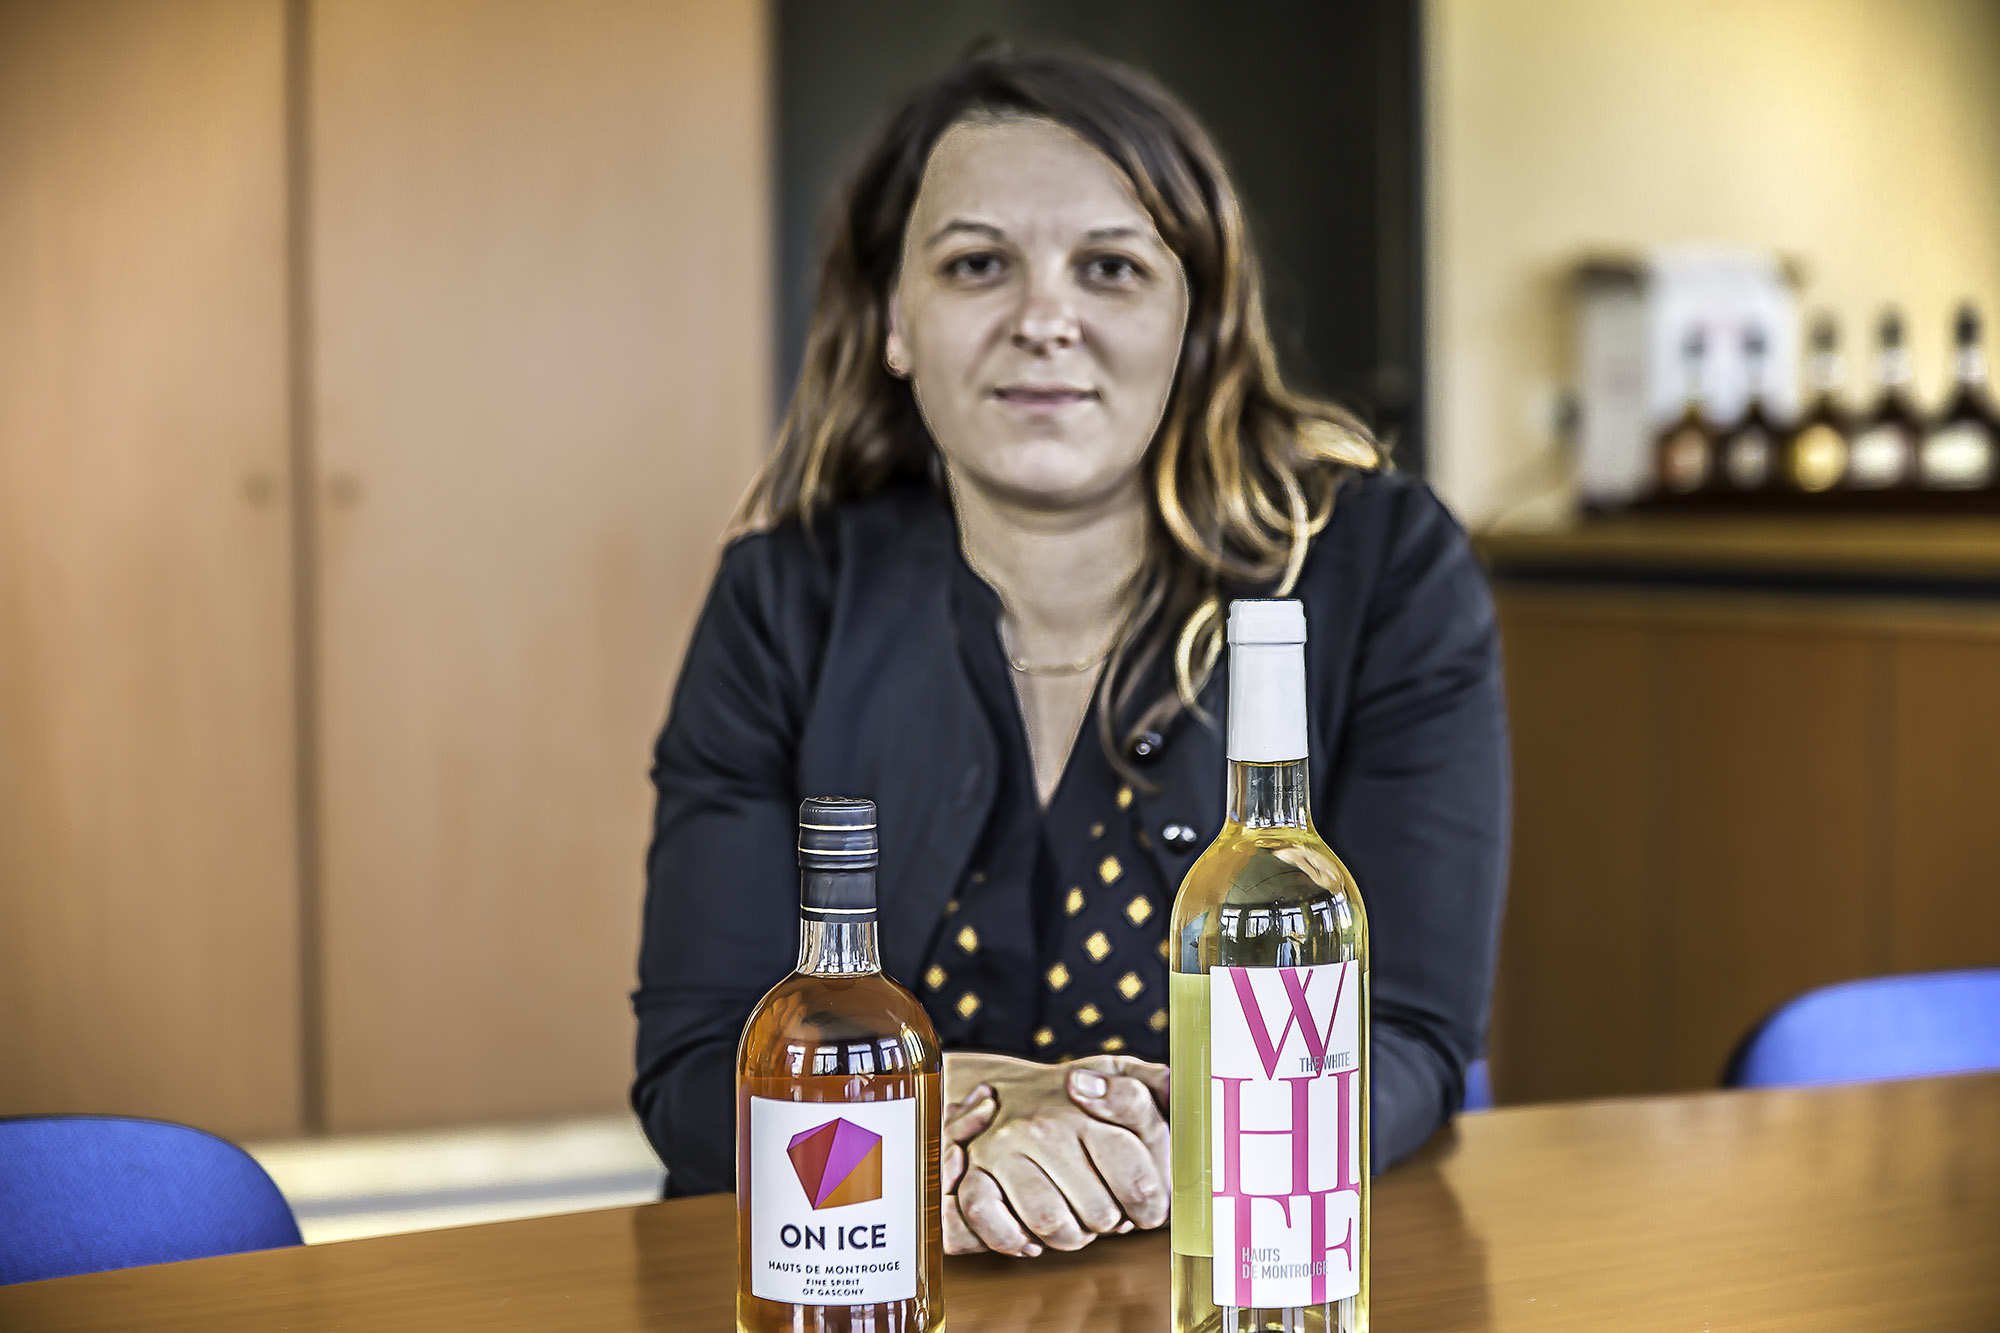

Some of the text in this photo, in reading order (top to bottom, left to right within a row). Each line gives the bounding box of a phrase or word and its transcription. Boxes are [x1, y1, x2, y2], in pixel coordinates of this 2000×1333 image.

[1299, 1051, 1350, 1072] THE WHITE
[780, 1224, 886, 1250] ON ICE
[1242, 1246, 1280, 1262] HAUTS
[768, 1260, 900, 1274] HAUTS DE MONTROUGE
[1242, 1260, 1329, 1279] DE MONTROUGE
[806, 1279, 860, 1287] FINE SPIRIT
[802, 1288, 864, 1296] OF GASCONY
